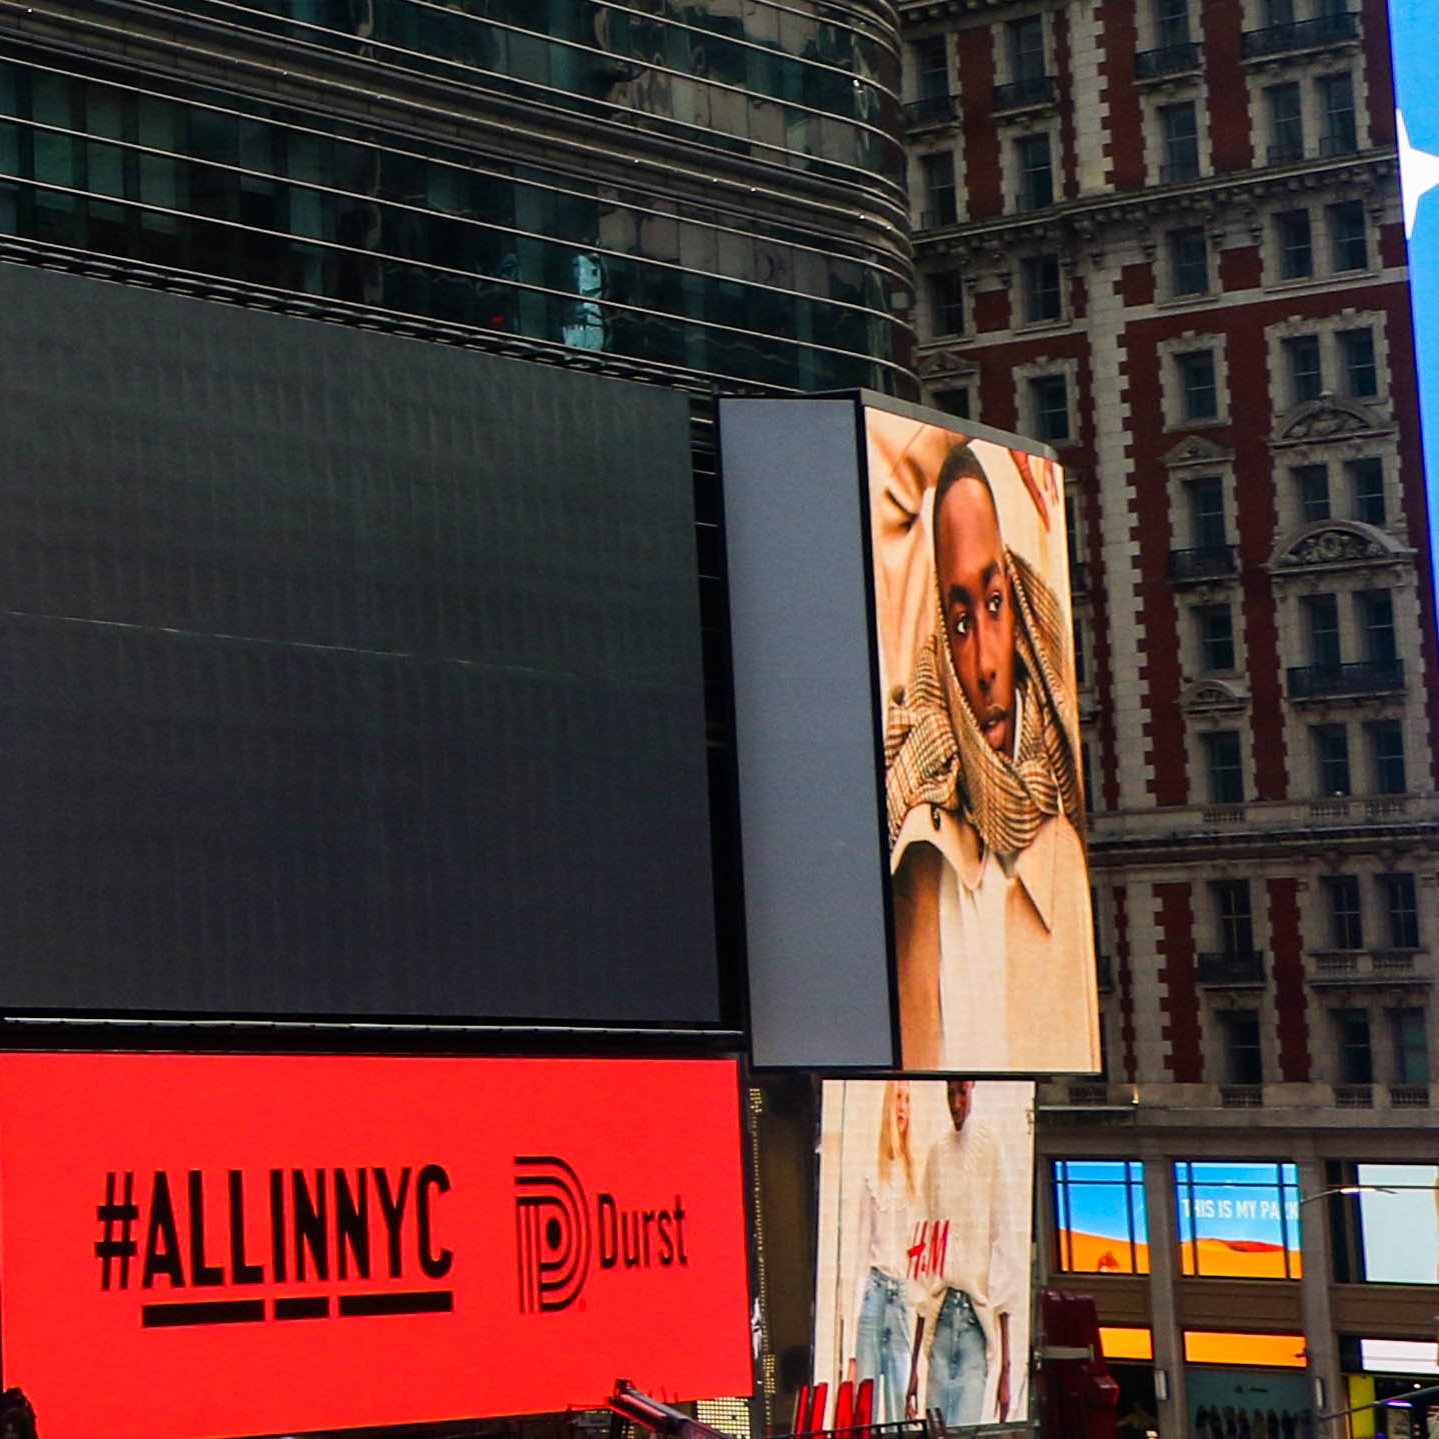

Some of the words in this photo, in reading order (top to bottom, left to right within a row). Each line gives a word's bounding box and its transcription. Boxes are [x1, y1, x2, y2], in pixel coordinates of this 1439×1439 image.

[95, 1163, 454, 1291] #ALLINNYC
[597, 1193, 688, 1270] Durst
[1217, 1199, 1233, 1219] IS
[1235, 1200, 1257, 1220] MY
[906, 1219, 951, 1281] H&M
